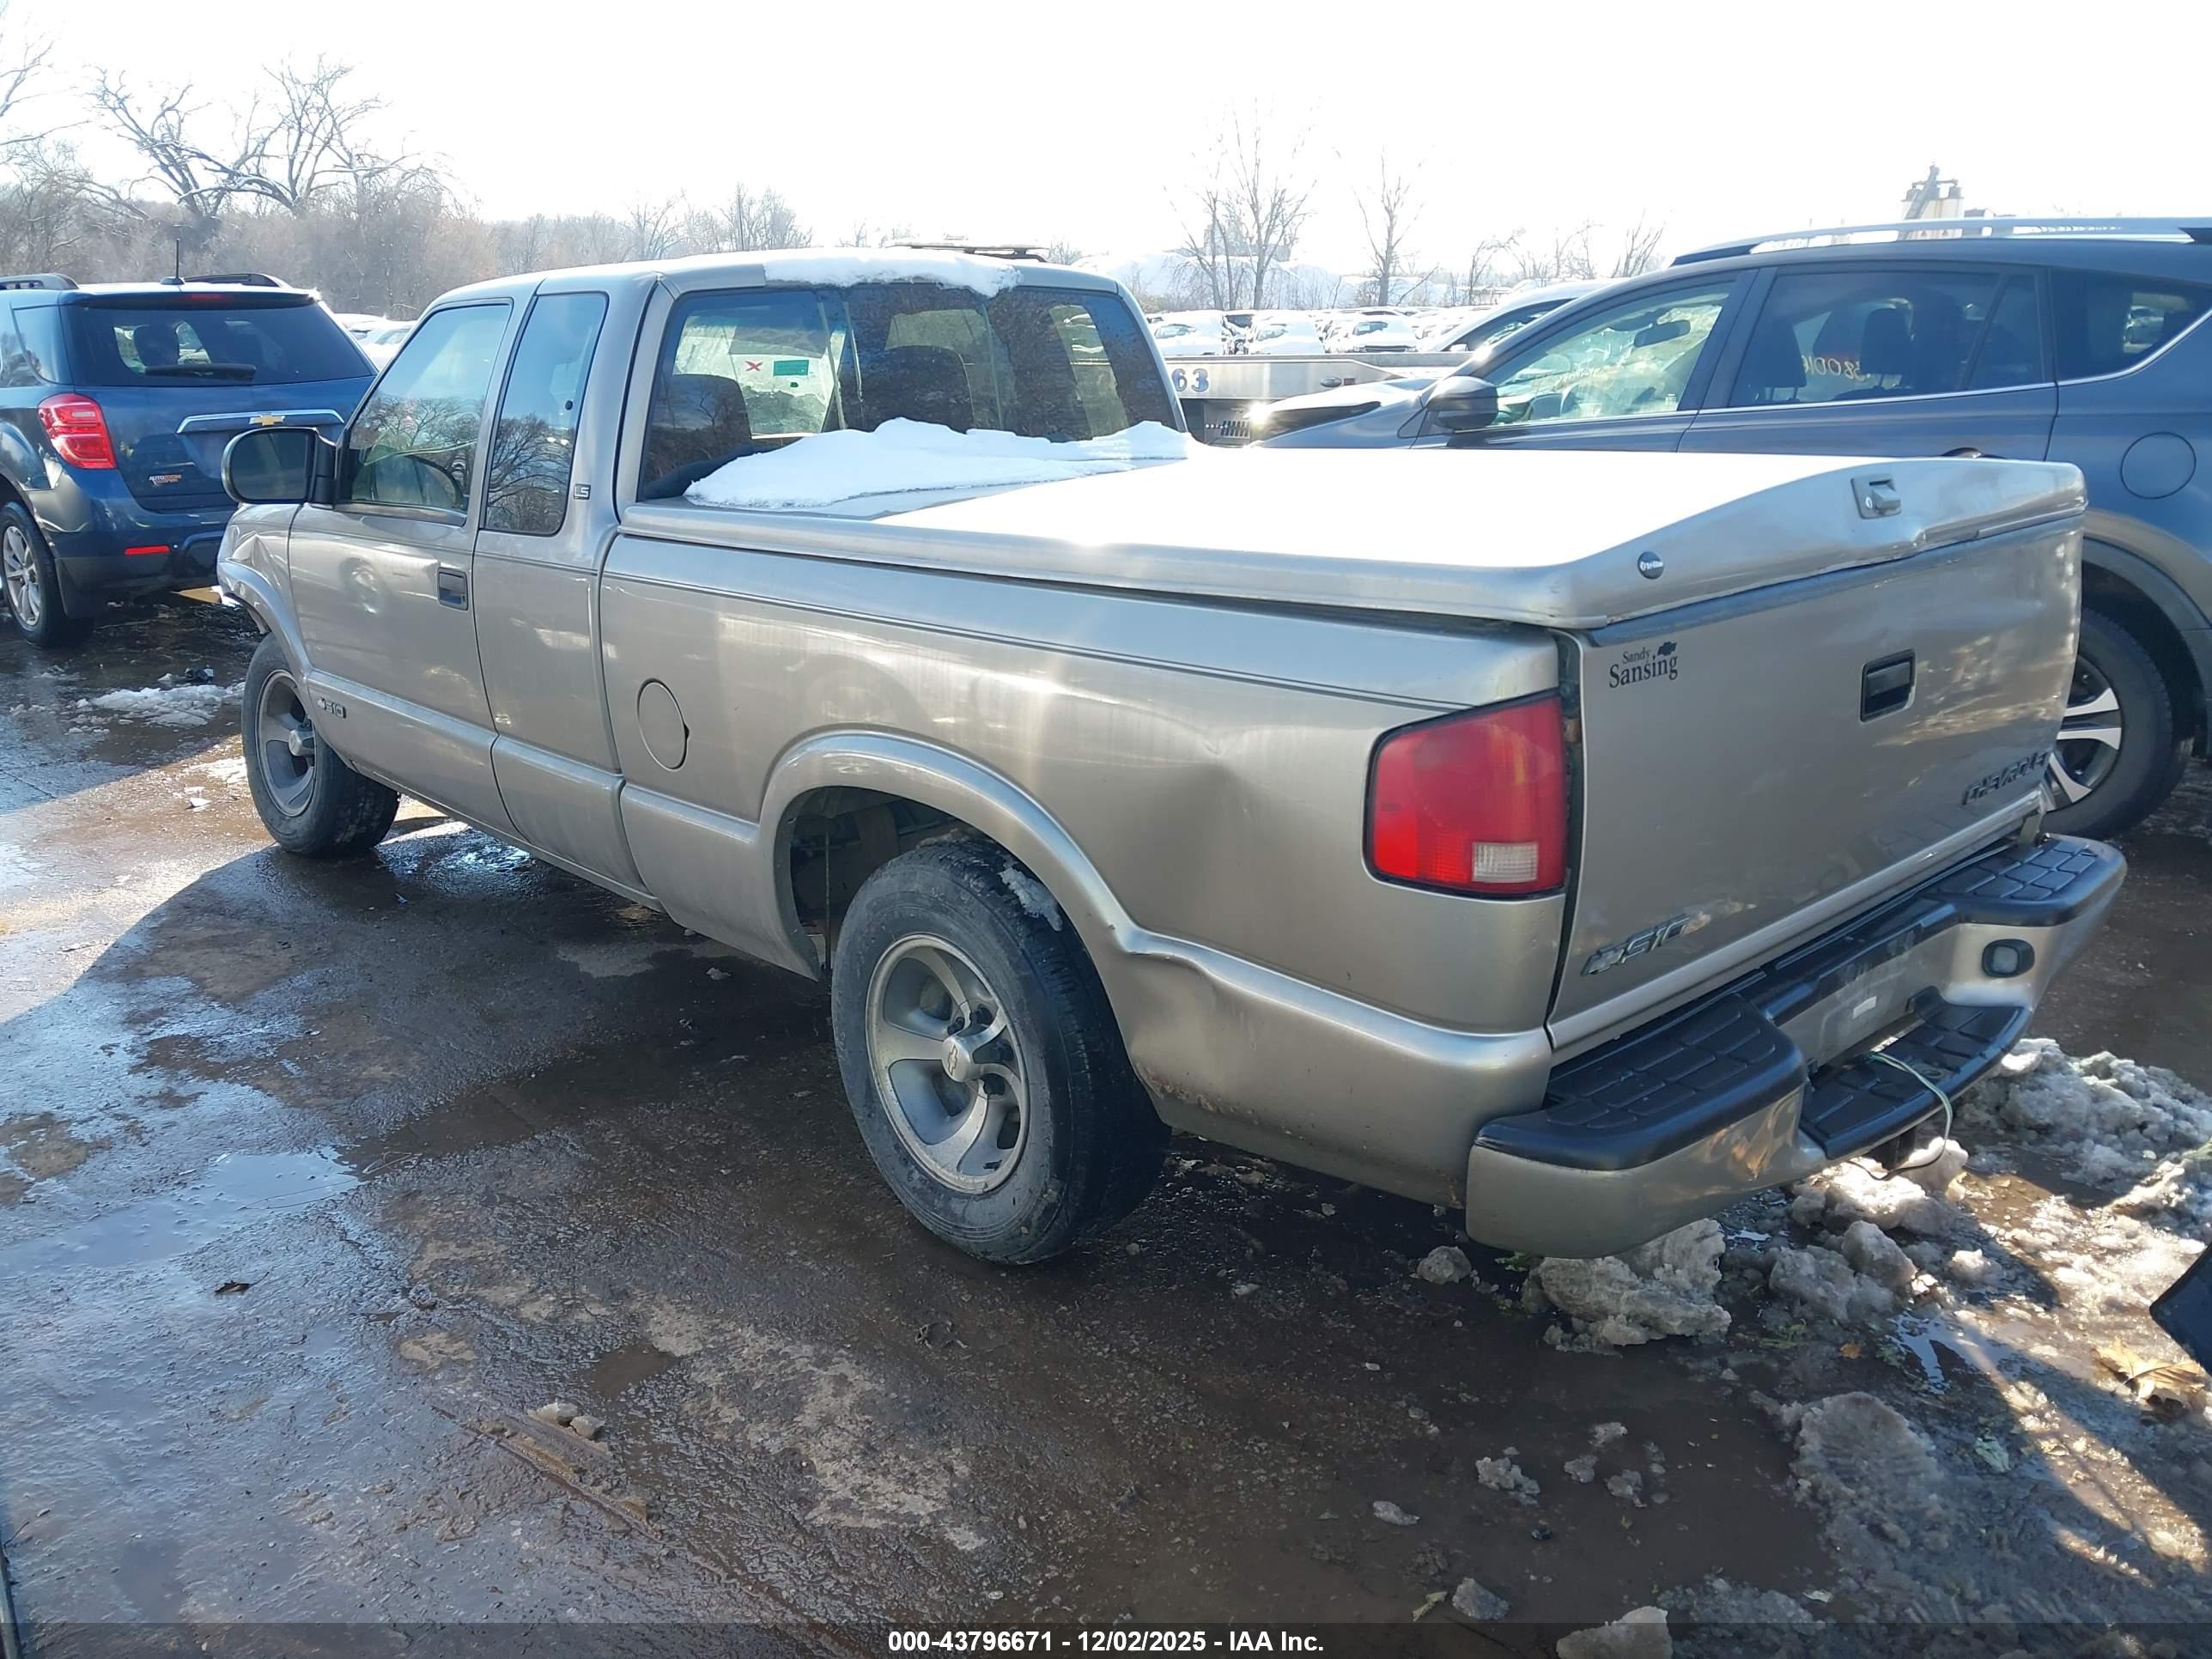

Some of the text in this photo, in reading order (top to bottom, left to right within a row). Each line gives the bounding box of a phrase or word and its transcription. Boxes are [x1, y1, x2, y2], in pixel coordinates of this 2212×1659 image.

[1171, 368, 1210, 392] 63
[574, 485, 590, 498] LS
[1622, 647, 1650, 664] Sandy
[1609, 655, 1678, 689] Sansing
